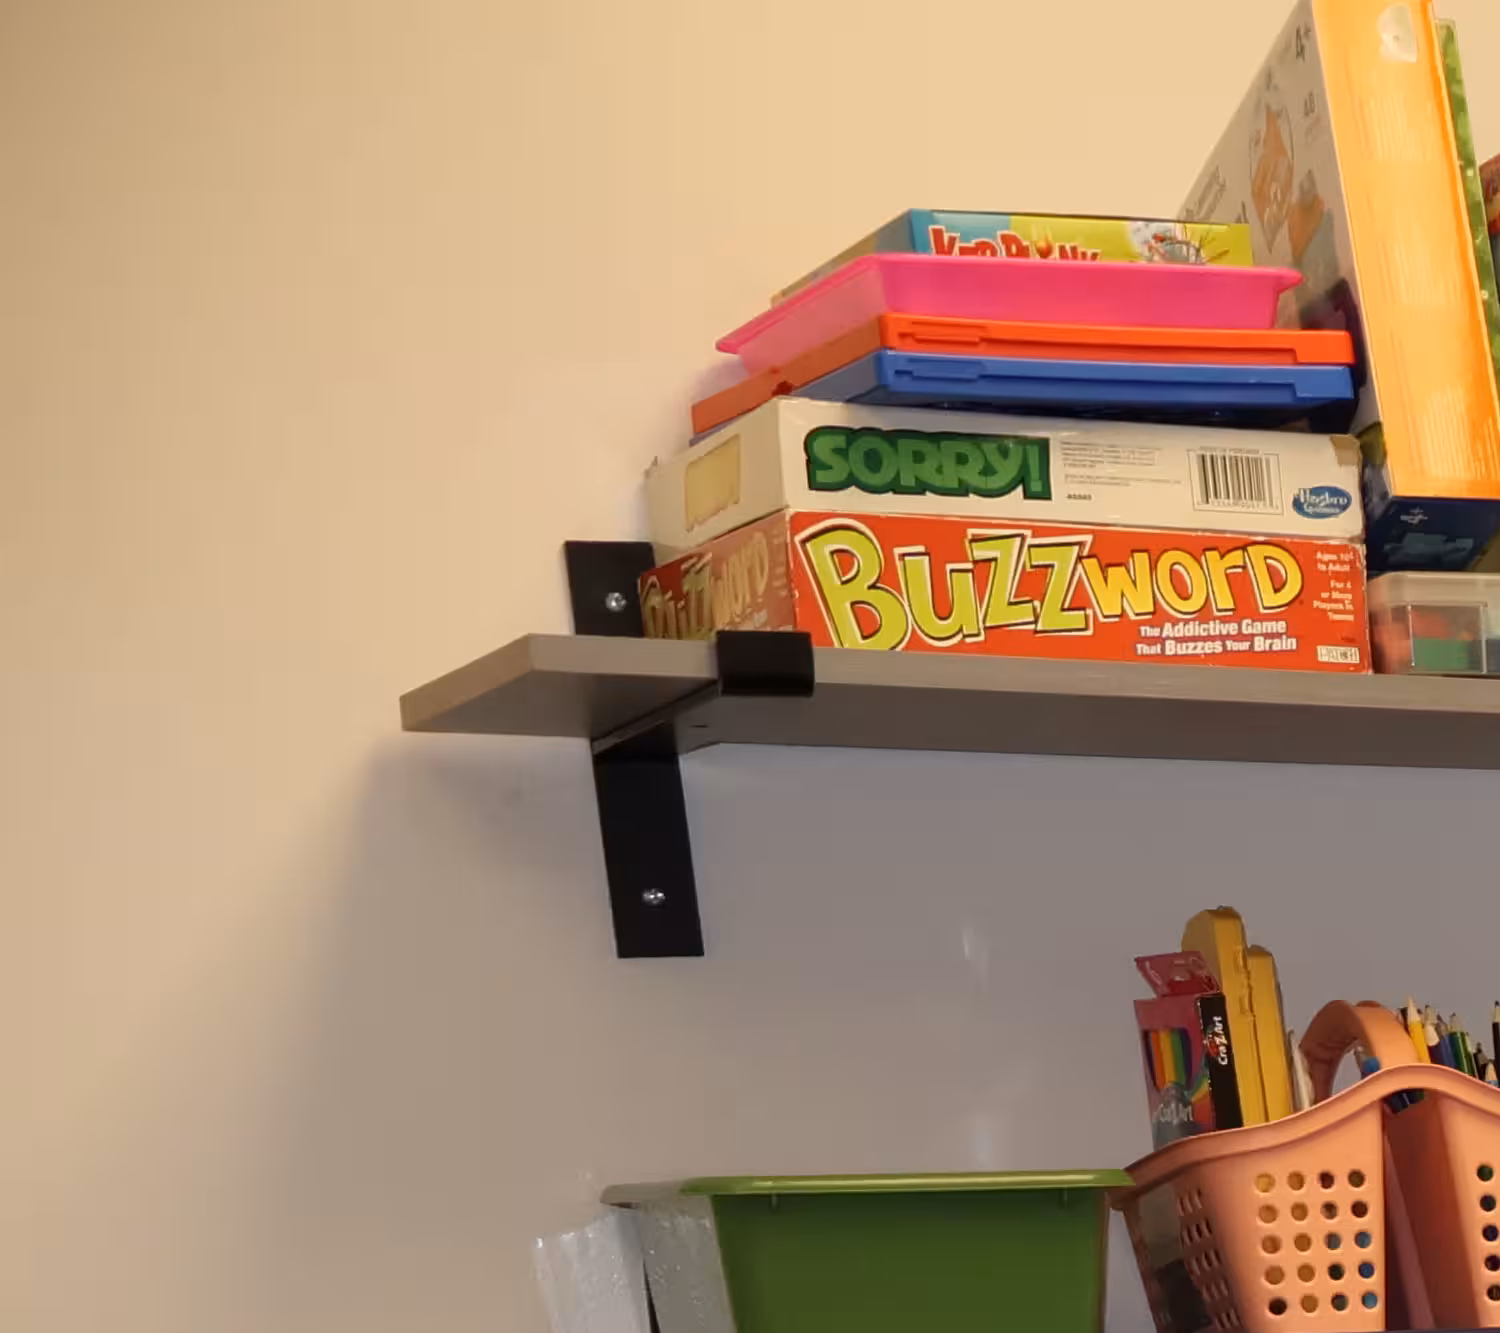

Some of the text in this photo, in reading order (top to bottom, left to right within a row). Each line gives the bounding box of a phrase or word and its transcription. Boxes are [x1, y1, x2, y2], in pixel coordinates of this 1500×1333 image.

[807, 428, 1052, 499] SORRY!
[1139, 618, 1287, 639] The Addictive Game
[1136, 635, 1297, 656] That Buzzes Your Brain
